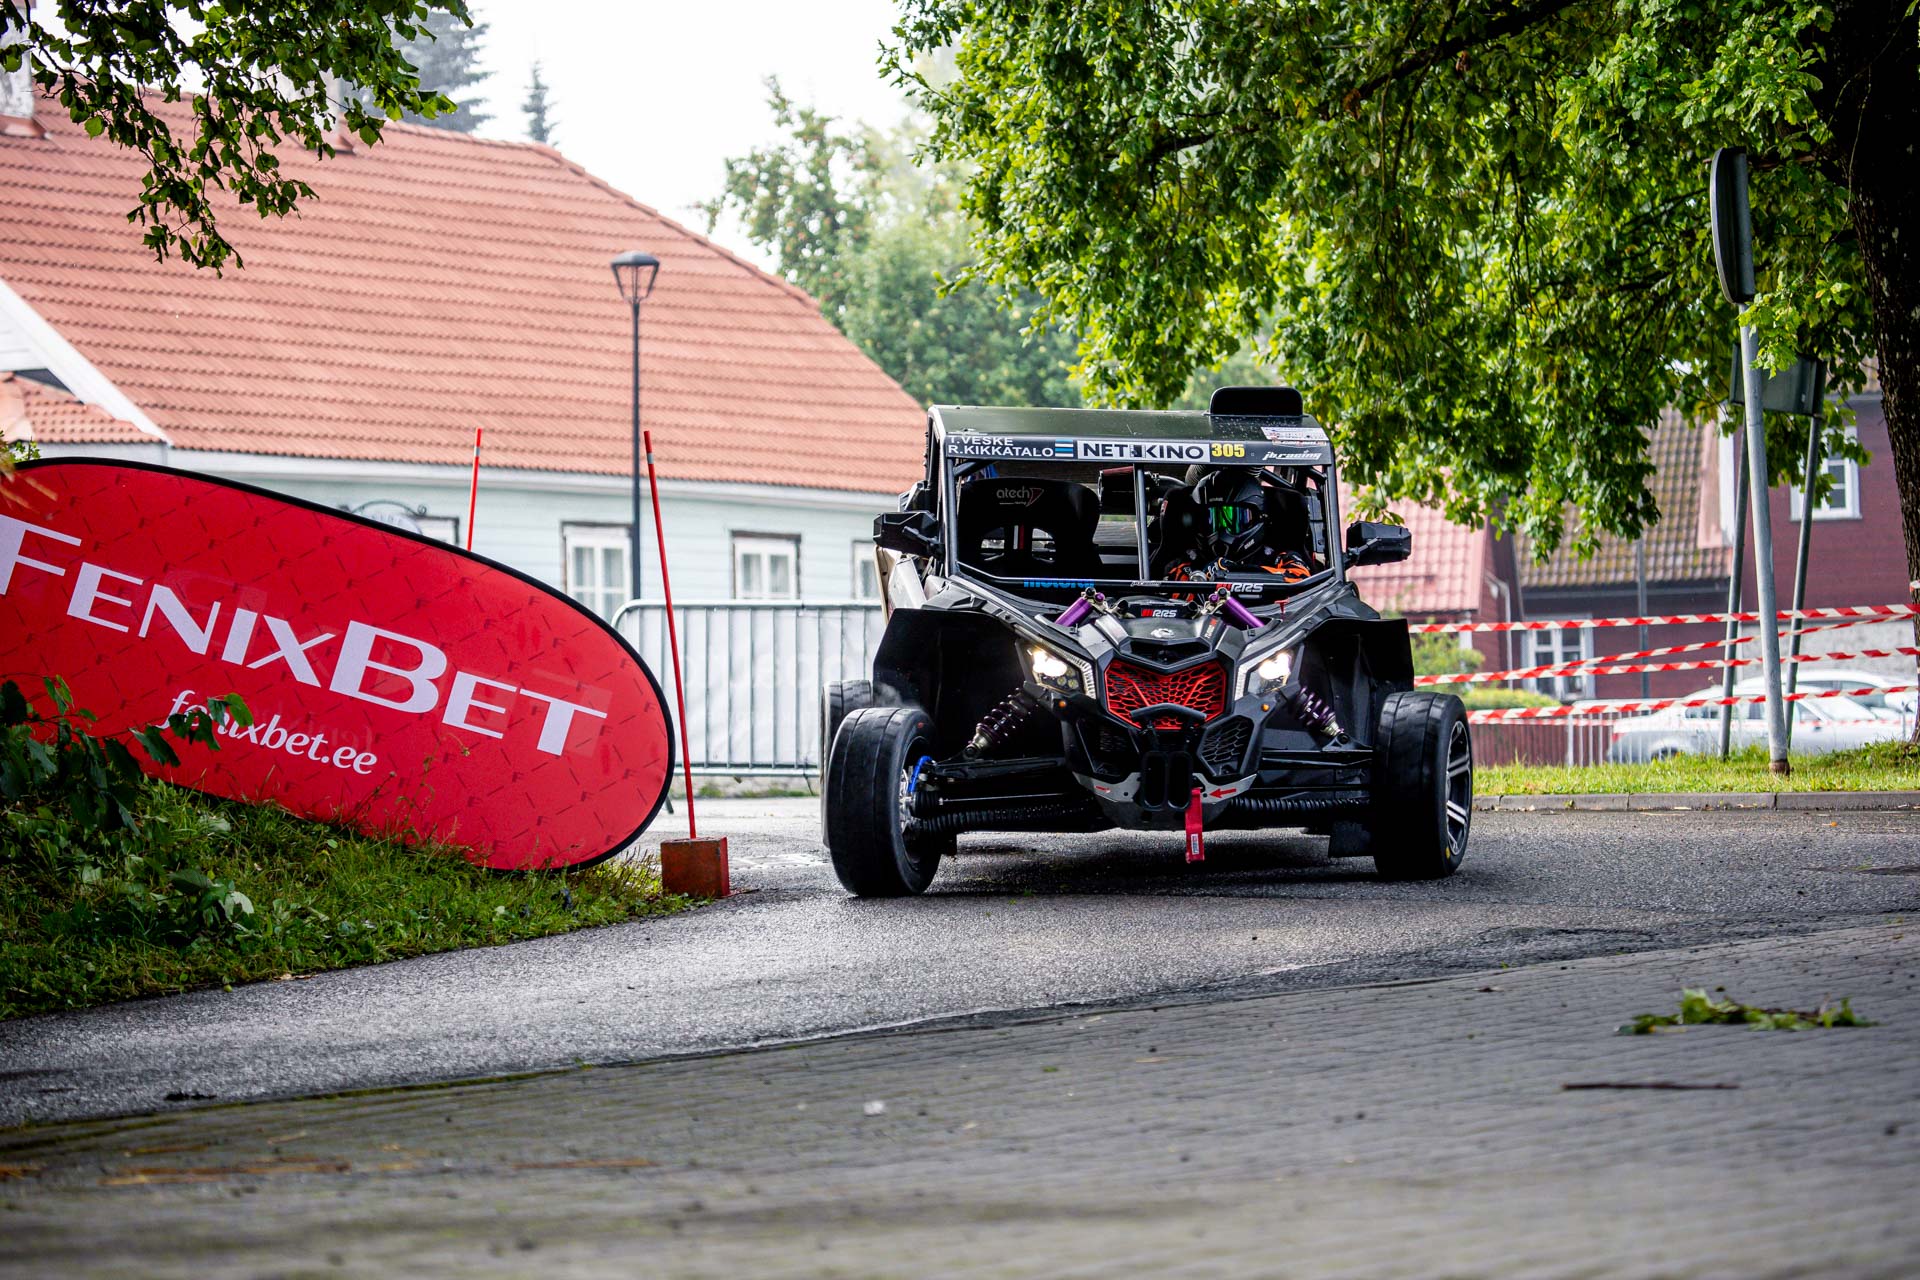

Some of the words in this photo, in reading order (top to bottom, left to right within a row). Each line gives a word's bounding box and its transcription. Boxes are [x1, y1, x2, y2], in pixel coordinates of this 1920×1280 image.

[949, 436, 1014, 446] T.VESKE
[948, 445, 1054, 457] R.KIKKATALO
[1211, 443, 1246, 458] 305
[1230, 583, 1264, 592] RRS
[1152, 609, 1177, 617] RRS
